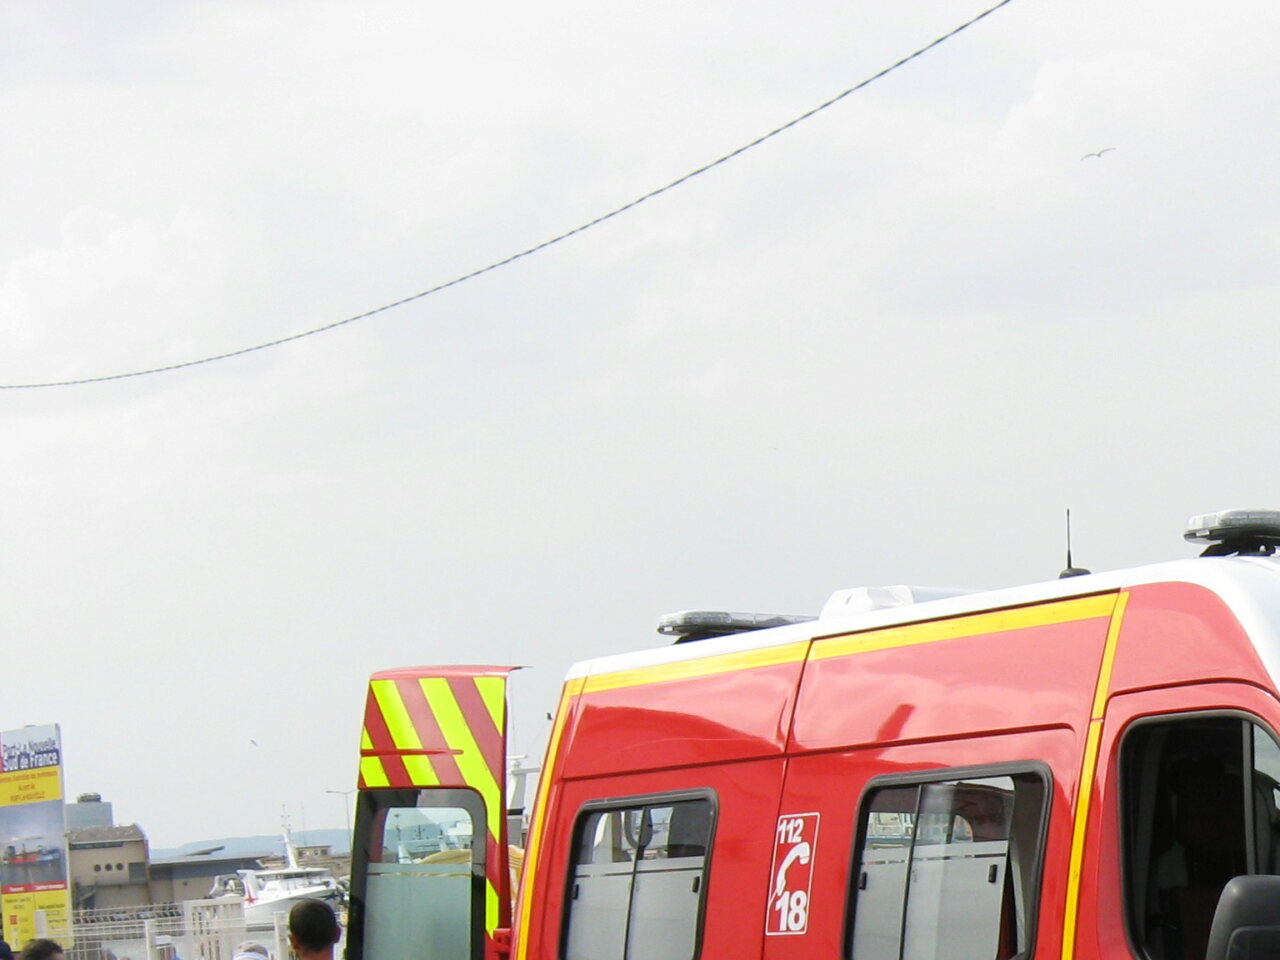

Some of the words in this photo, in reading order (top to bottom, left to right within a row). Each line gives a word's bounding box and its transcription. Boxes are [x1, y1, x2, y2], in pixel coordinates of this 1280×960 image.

[31, 751, 58, 768] France
[778, 818, 804, 844] 112
[775, 890, 807, 931] 18
